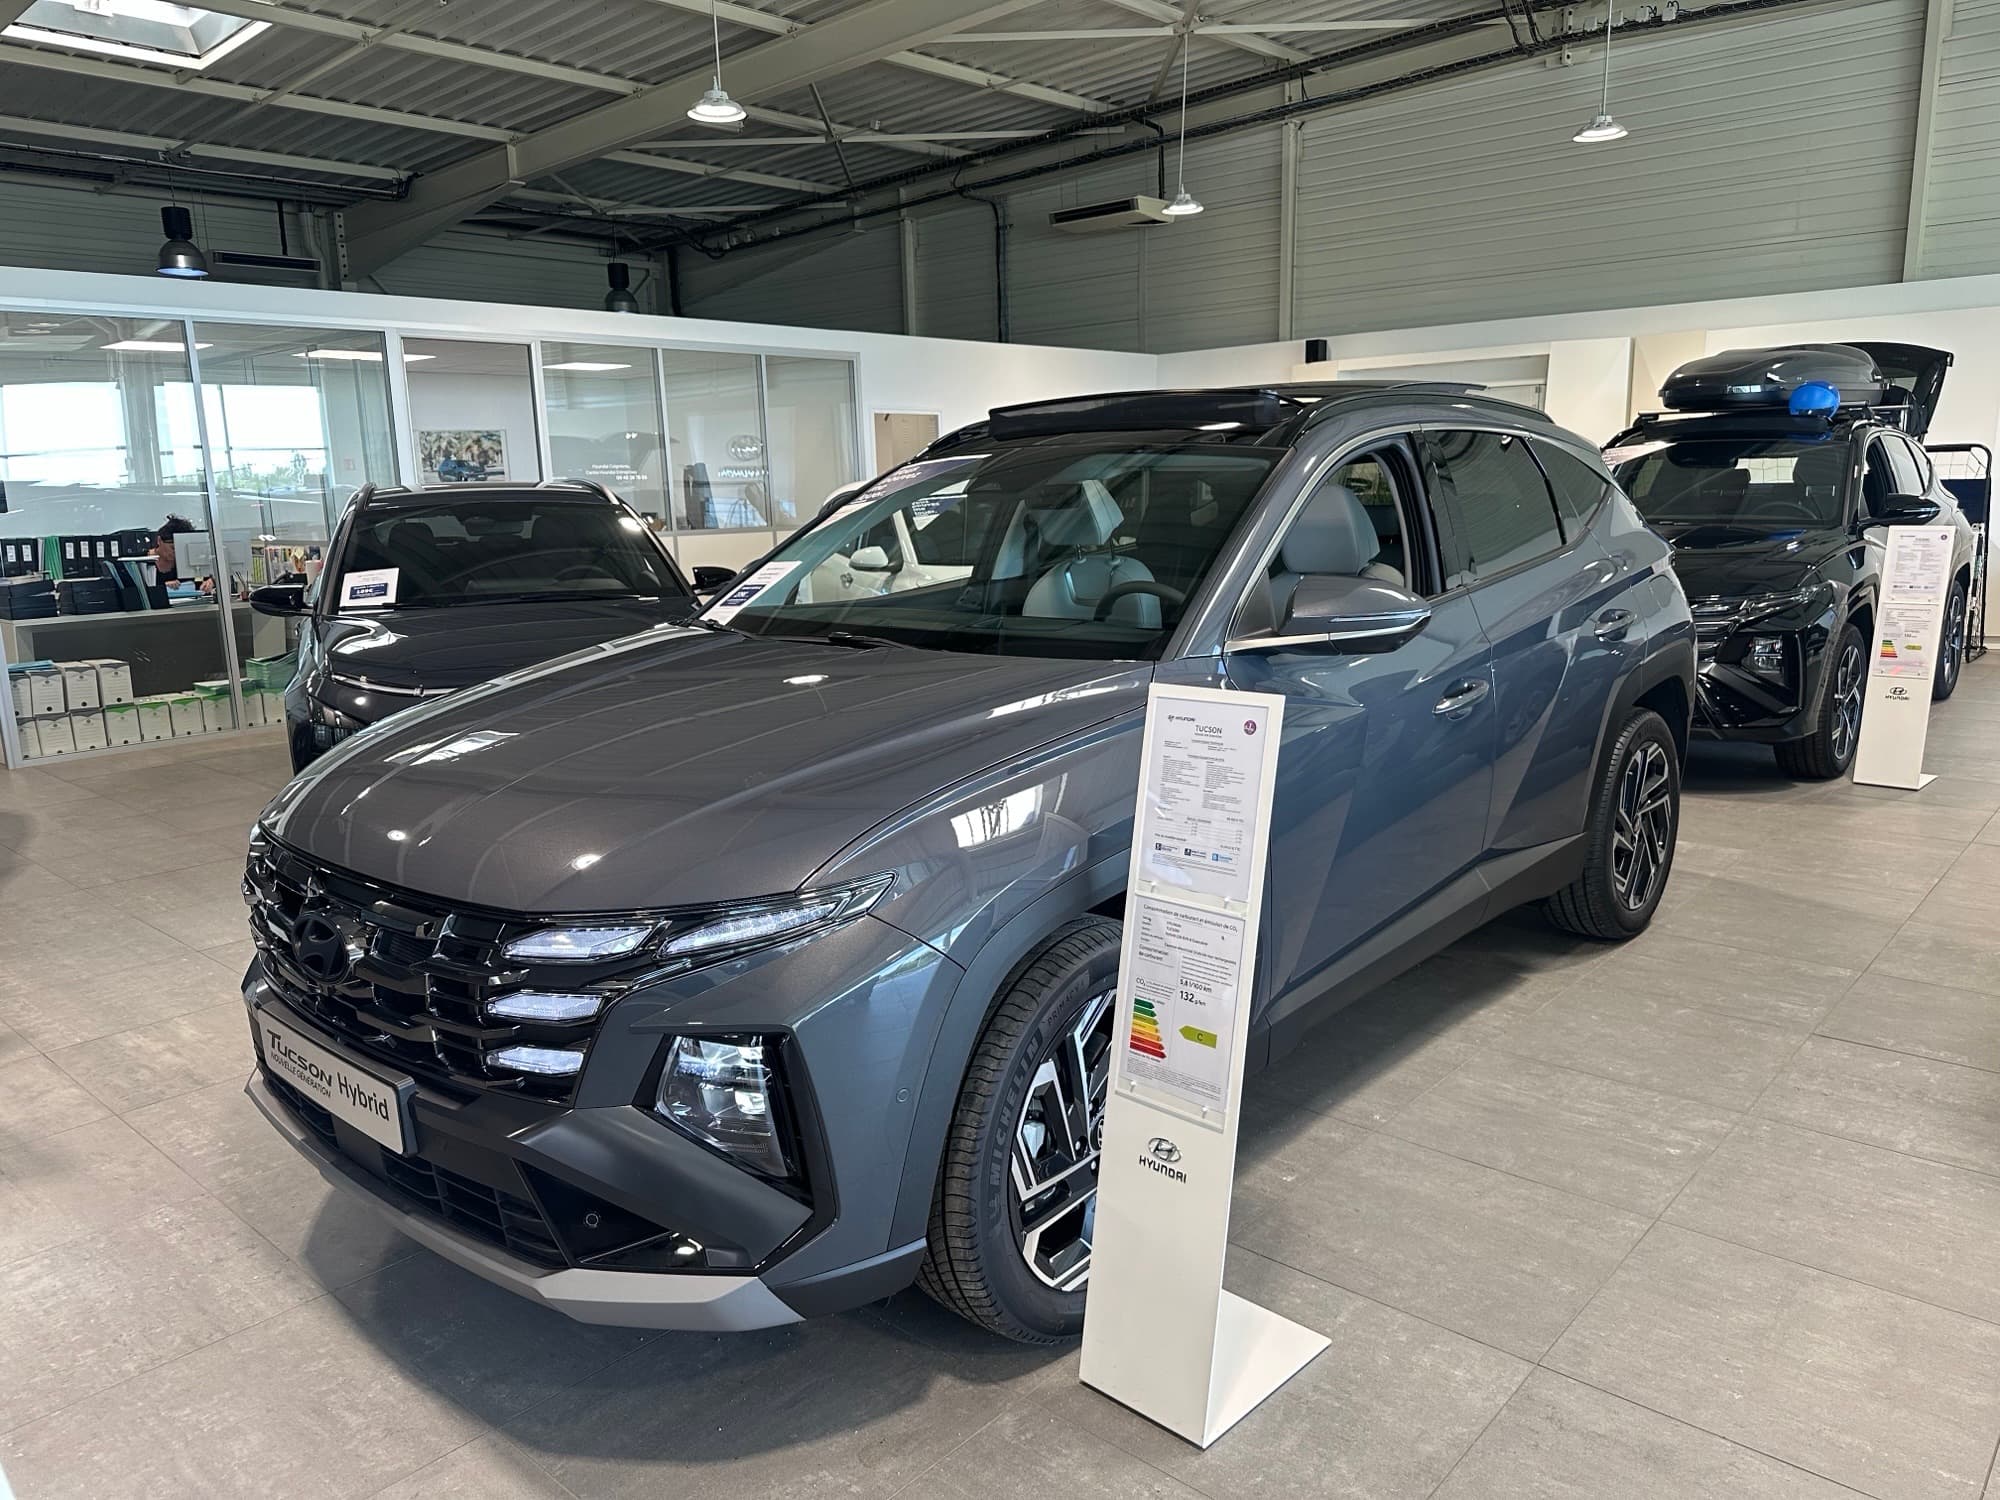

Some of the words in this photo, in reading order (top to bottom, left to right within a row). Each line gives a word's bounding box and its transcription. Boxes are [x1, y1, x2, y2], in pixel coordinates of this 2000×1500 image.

[1195, 724, 1223, 734] TUCSON
[1180, 990, 1195, 1003] 132
[1196, 1033, 1204, 1042] C
[337, 1072, 389, 1121] Hybrid
[989, 1028, 1043, 1186] MICHELIN
[1139, 1154, 1187, 1184] HYUNDAI
